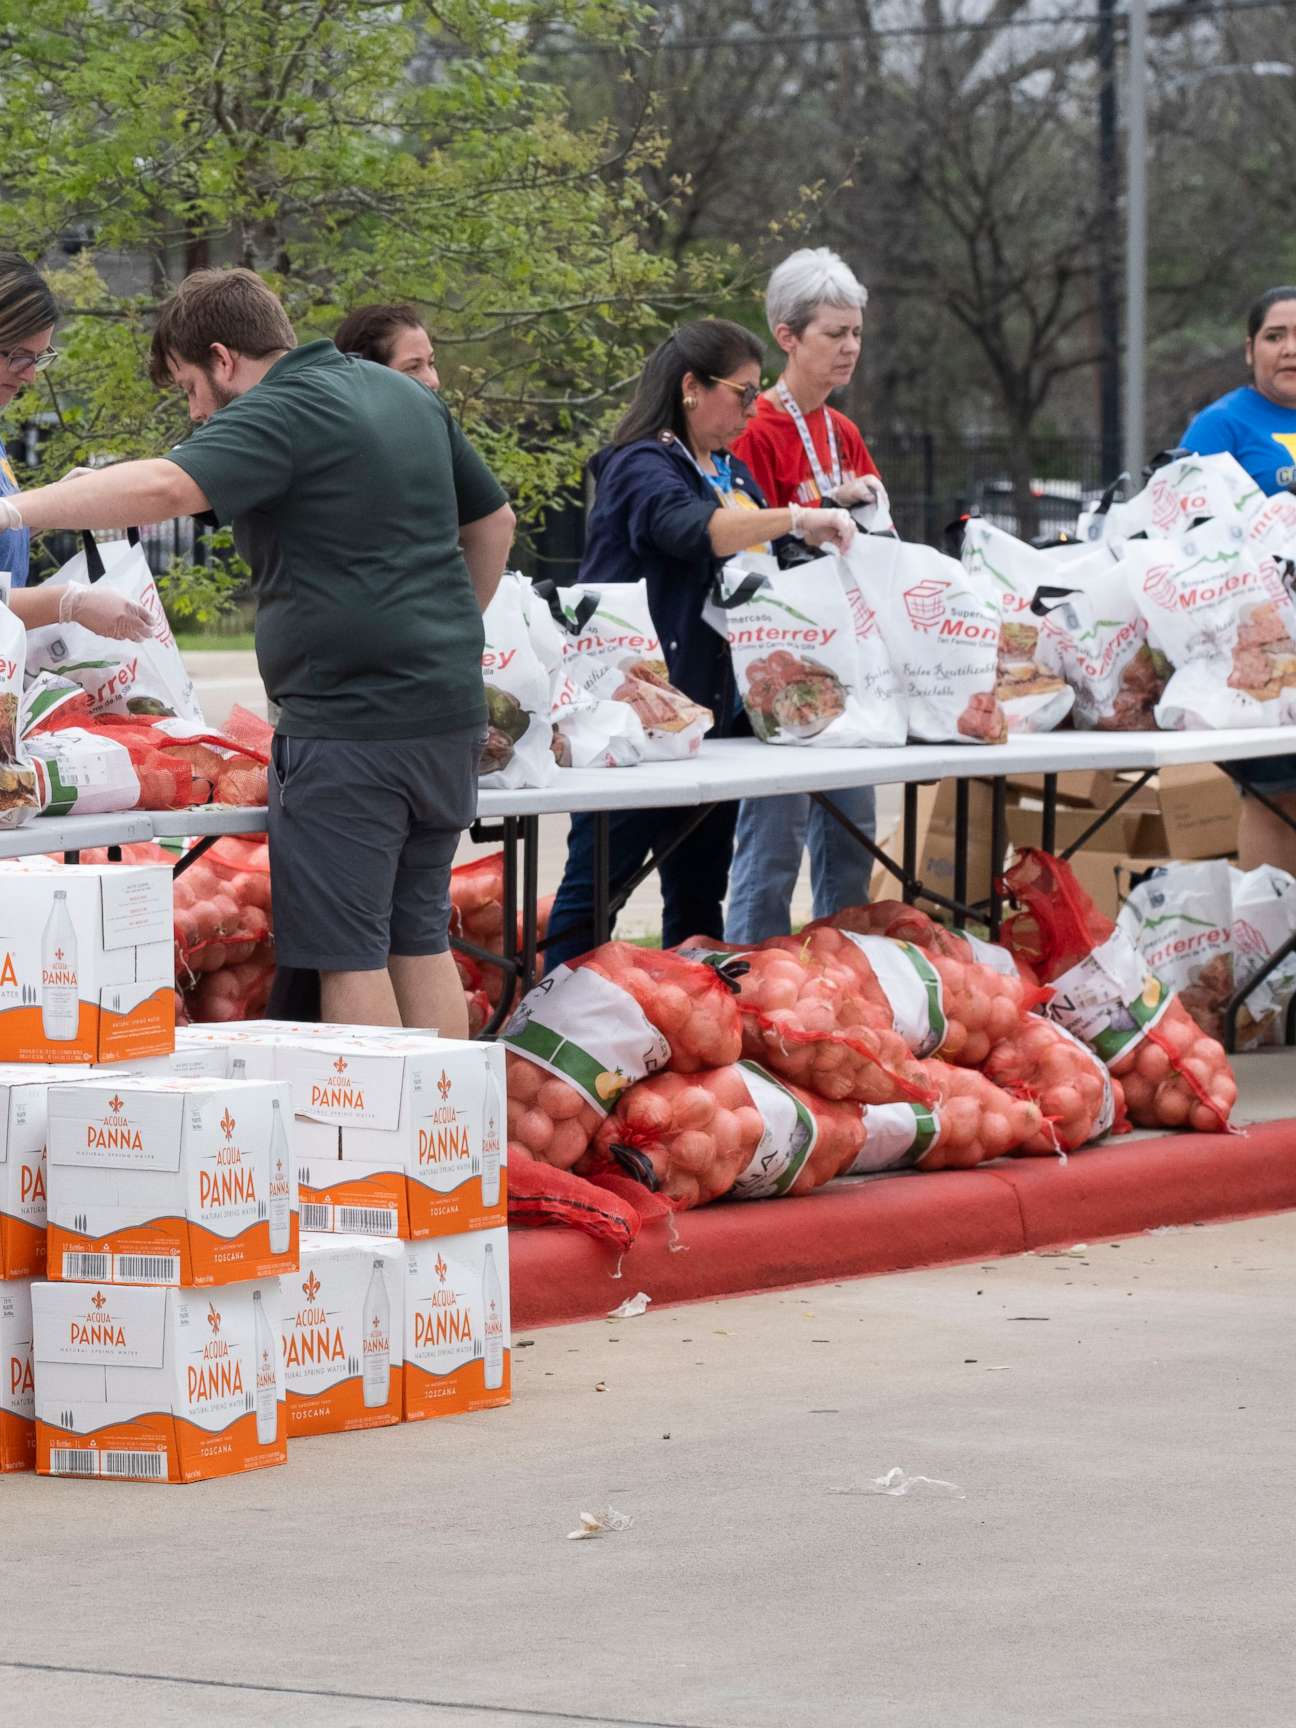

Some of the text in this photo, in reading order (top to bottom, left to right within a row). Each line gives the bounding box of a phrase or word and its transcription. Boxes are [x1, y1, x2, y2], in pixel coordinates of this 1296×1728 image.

[727, 627, 837, 645] onterrey
[86, 657, 138, 707] errey
[1146, 927, 1232, 966] nterrey
[42, 970, 78, 984] PANNA
[327, 1077, 351, 1087] ACQUA
[311, 1085, 365, 1110] PANNA
[103, 1116, 128, 1127] ACQUA
[433, 1108, 457, 1124] ACQUA
[87, 1126, 143, 1151] PANNA
[418, 1126, 470, 1165] PANNA
[216, 1147, 241, 1165] ACQUA
[199, 1166, 256, 1208] PANNA
[269, 1182, 289, 1196] PANNA
[430, 1205, 459, 1216] TOSCANA
[214, 1252, 244, 1262] TOSCANA
[431, 1292, 457, 1308] ACQUA
[86, 1313, 112, 1323] ACQUA
[295, 1307, 327, 1328] ACQUA
[70, 1323, 126, 1347] PANNA
[415, 1309, 472, 1348] PANNA
[484, 1320, 502, 1334] PANNA
[203, 1341, 229, 1360] ACQUA
[363, 1337, 389, 1353] PANNA
[327, 1364, 346, 1373] WATER
[187, 1359, 243, 1404] PANNA
[256, 1374, 276, 1388] PANNA
[424, 1388, 457, 1399] TOSCANA
[291, 1407, 331, 1420] TOSCANA
[200, 1444, 232, 1456] TOSCANA
